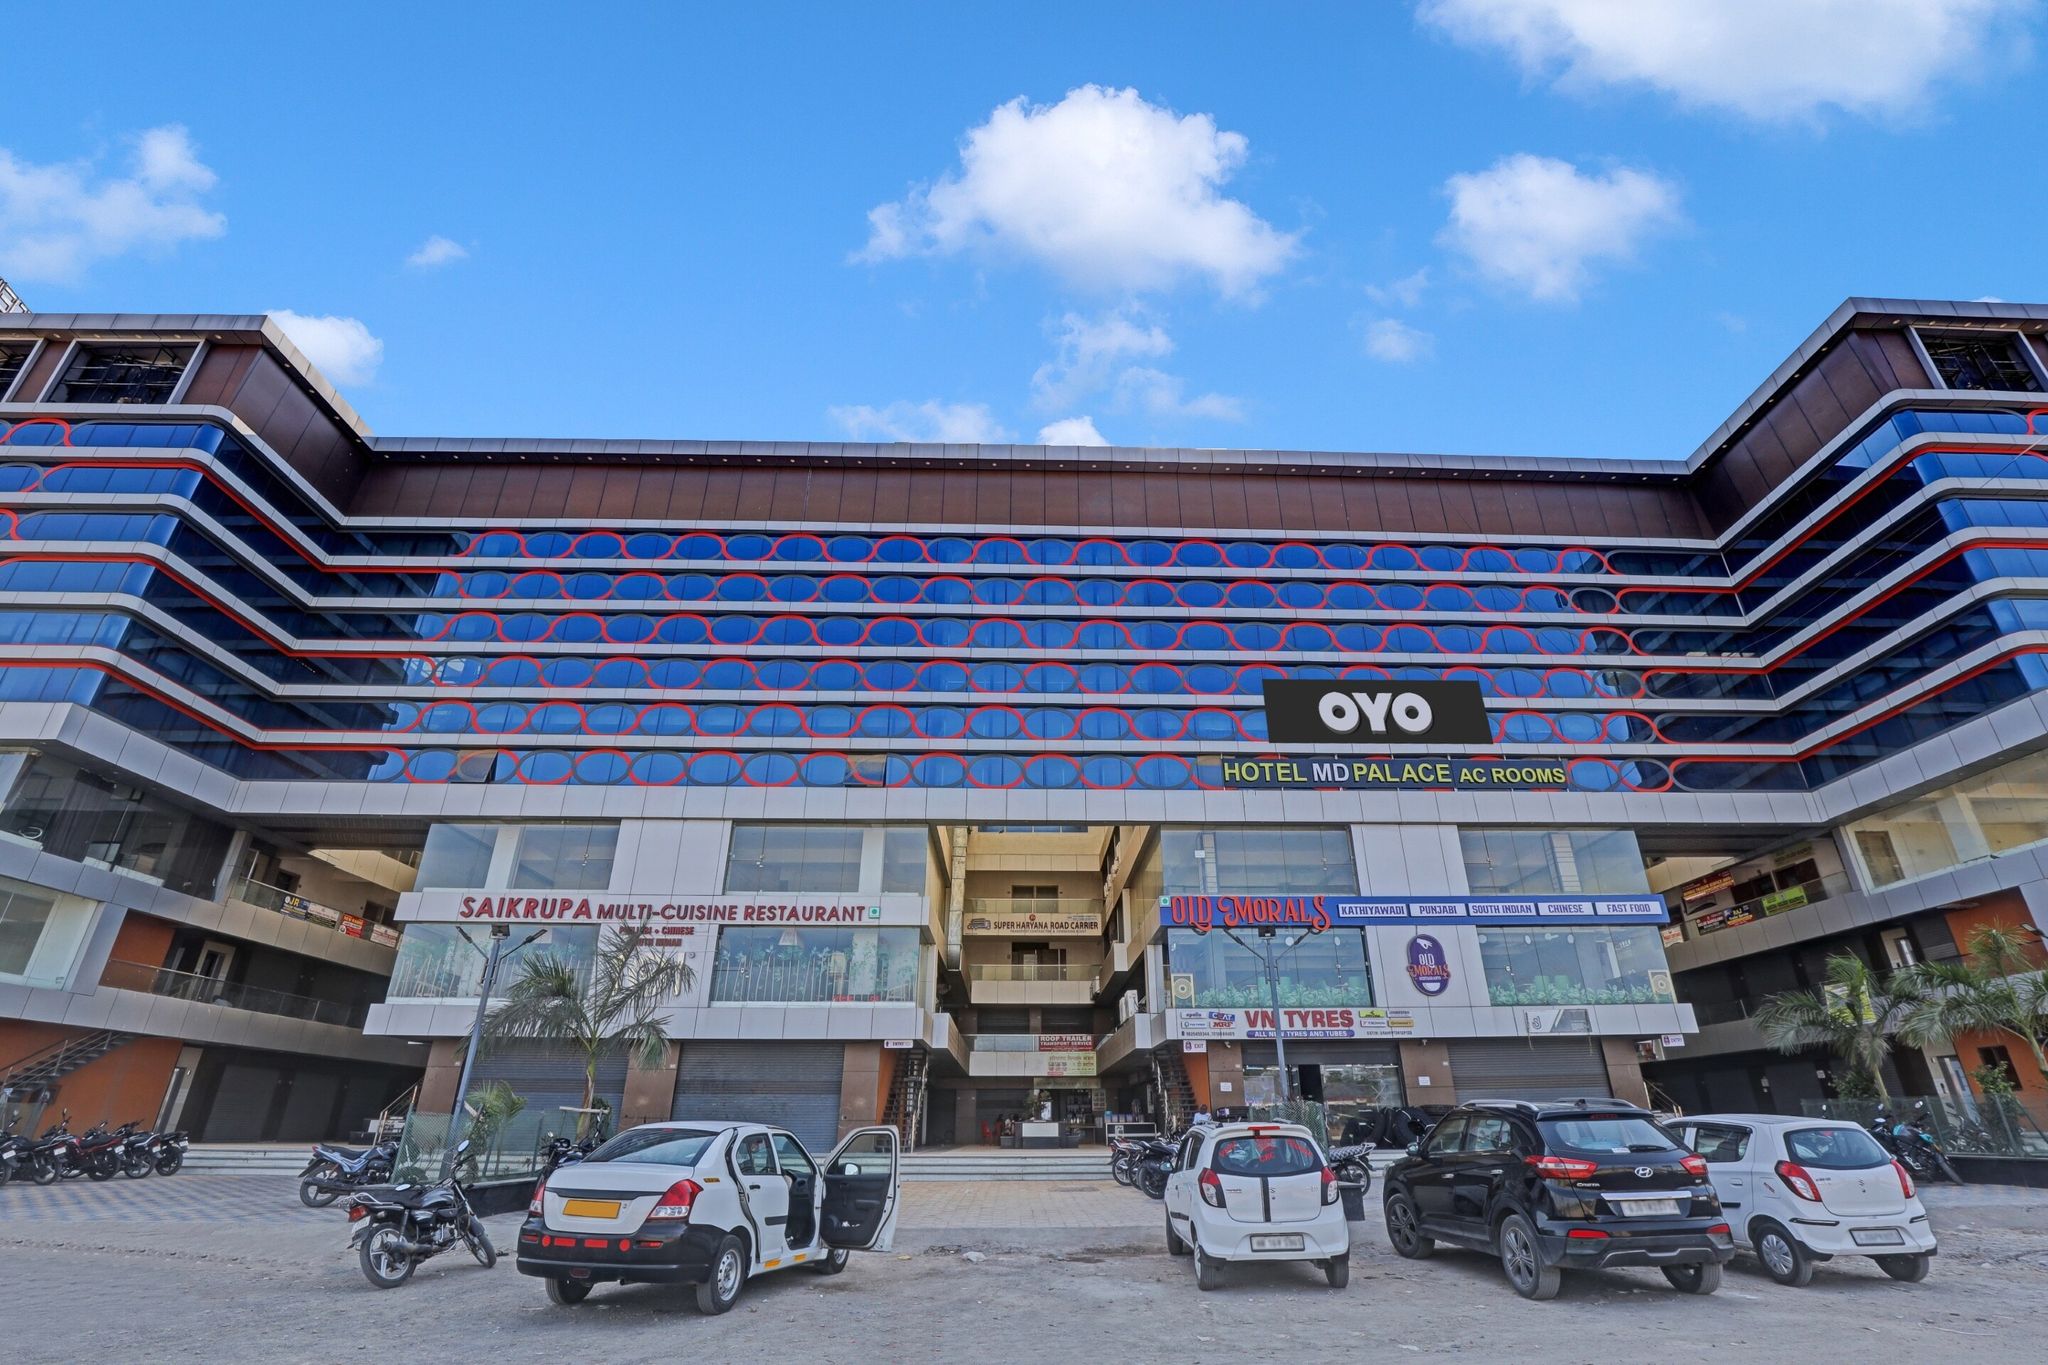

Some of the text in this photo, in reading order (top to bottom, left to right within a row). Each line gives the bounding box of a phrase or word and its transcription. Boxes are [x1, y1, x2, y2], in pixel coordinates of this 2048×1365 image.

[1318, 691, 1433, 734] OYO
[1224, 762, 1566, 784] HOTEL MD PALACE AC ROOMS
[460, 897, 866, 921] SAIKRUPA MULTI-CUISINE RESTAURANT
[1171, 895, 1331, 932] OLD MORALS
[1341, 905, 1405, 916] KATHIYAWADI
[1419, 905, 1457, 915] PUNJABI
[1472, 904, 1532, 914] SOUTH INDIAN
[1548, 904, 1584, 913] CHINESE
[1607, 903, 1651, 913] FAST FOOD
[993, 921, 1098, 930] SUPER HARYANA ROAD CARRIER
[1418, 953, 1435, 968] OLD
[1284, 1010, 1354, 1028] TYRES
